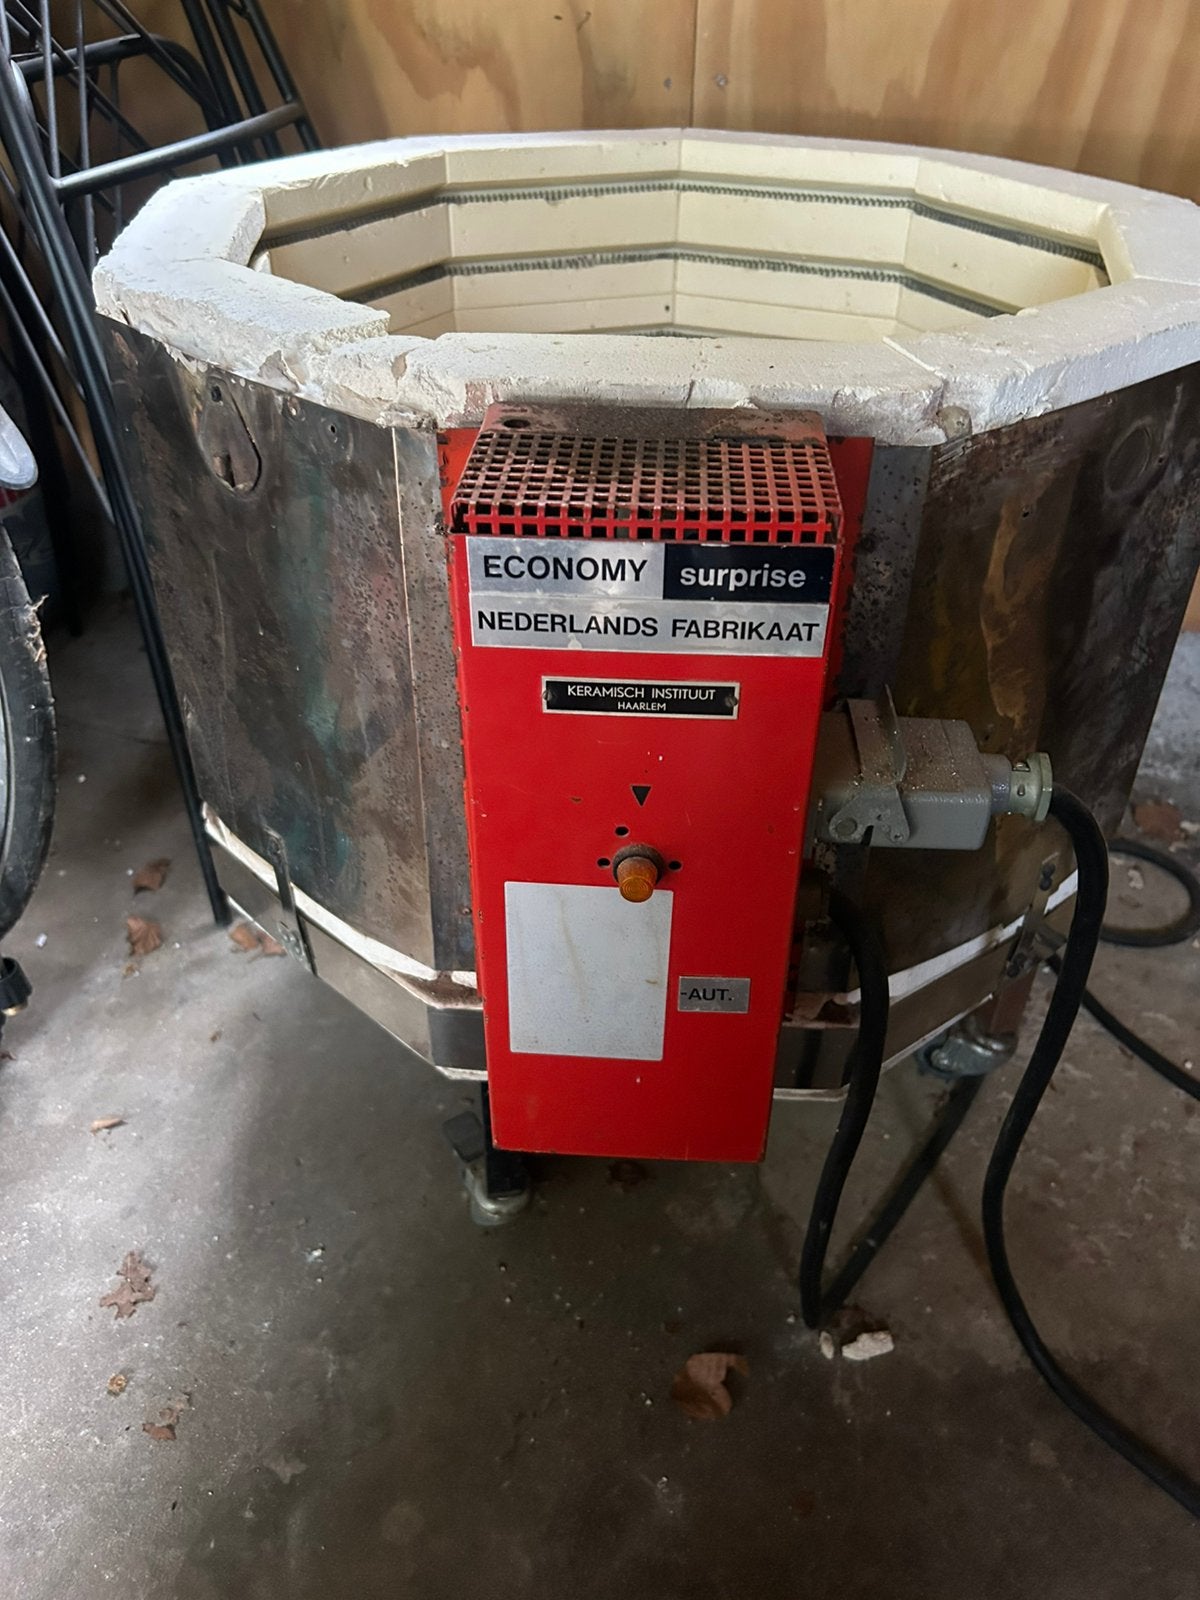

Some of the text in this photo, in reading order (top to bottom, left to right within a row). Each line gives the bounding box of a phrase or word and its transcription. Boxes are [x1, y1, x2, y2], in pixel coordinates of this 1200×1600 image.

[483, 554, 807, 592] ECONOMY surprise
[477, 610, 820, 642] NEDERLANDS FABRIKAAT
[567, 684, 716, 701] KERAMISCH INSTITUUT
[617, 701, 667, 712] HAARLEM
